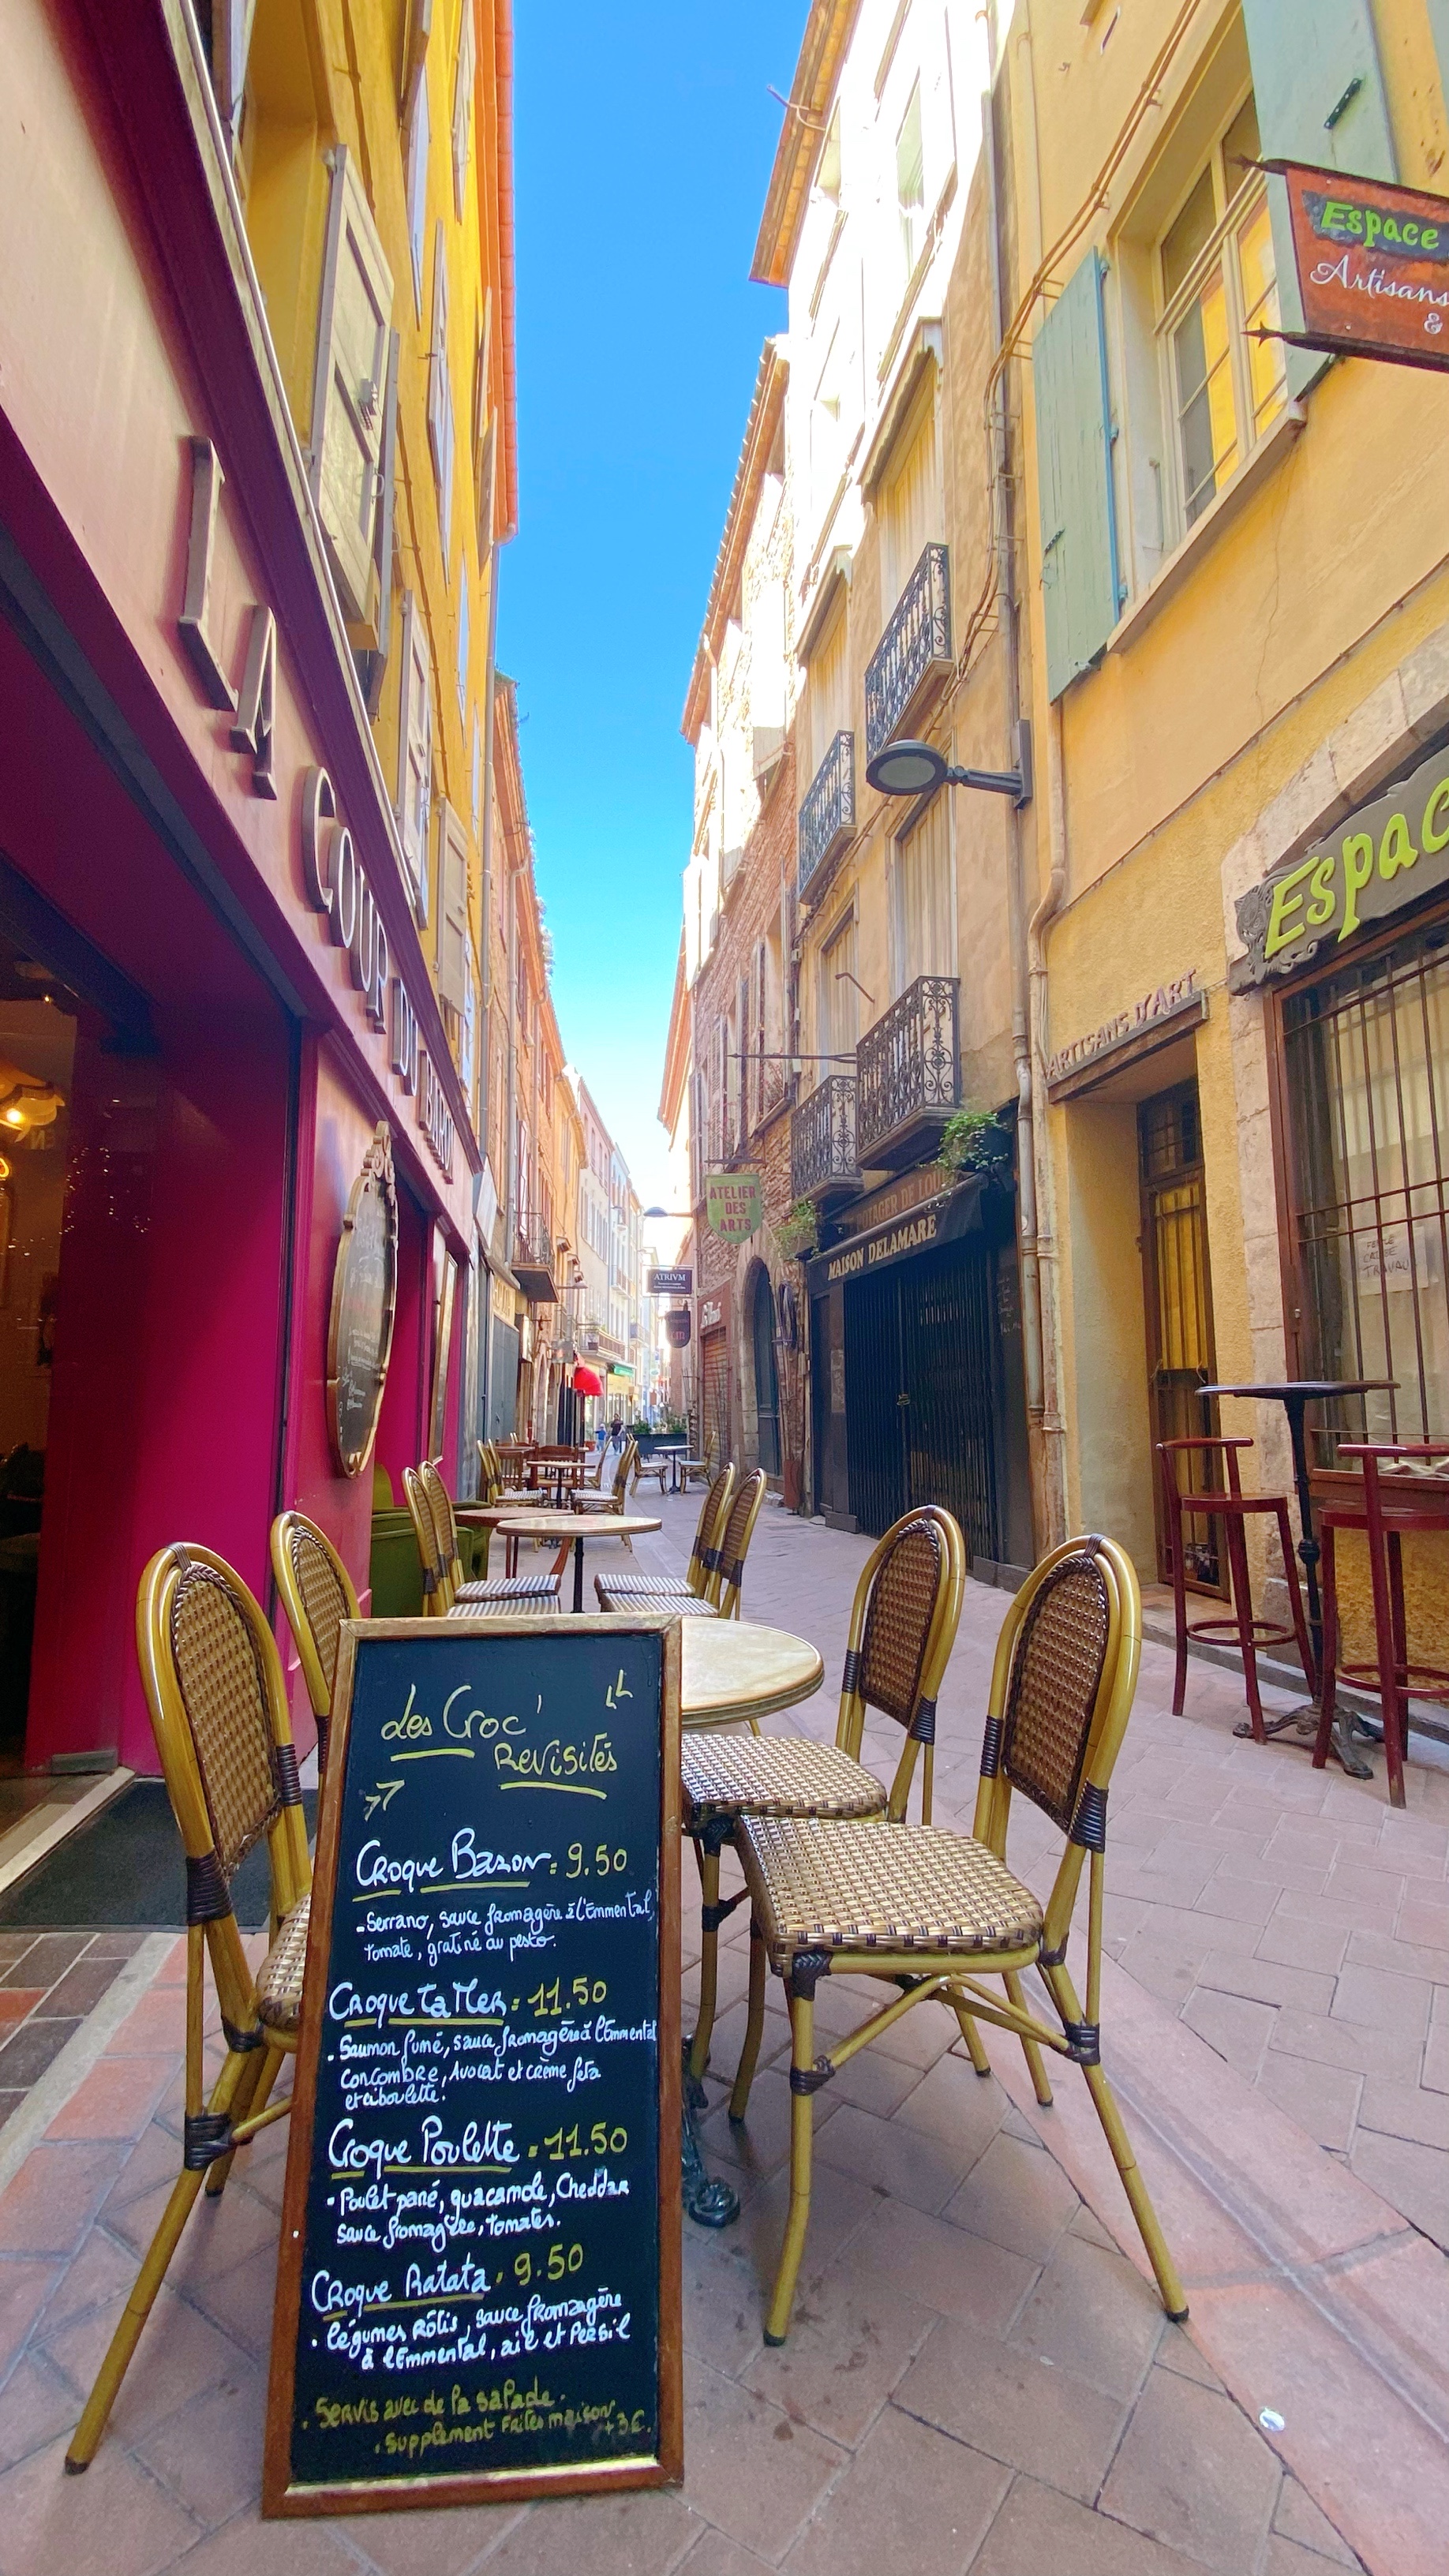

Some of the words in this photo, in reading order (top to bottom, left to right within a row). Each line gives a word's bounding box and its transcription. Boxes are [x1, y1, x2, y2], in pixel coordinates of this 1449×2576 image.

[1320, 200, 1440, 249] Espace
[1309, 253, 1449, 307] Artisans
[1423, 312, 1443, 335] &
[178, 435, 278, 801] LA
[301, 765, 388, 1035] COUR
[391, 977, 418, 1097] DU
[1046, 1012, 1129, 1080] ARTISANS
[709, 1185, 756, 1200] ATELIER
[724, 1201, 747, 1215] DES
[720, 1218, 751, 1232] ARTS
[827, 1247, 865, 1281] MAISON
[868, 1213, 938, 1264] DELAMARE
[565, 1842, 627, 1879] 9.50
[485, 1937, 504, 1950] au
[527, 1976, 608, 2017] 11.50
[544, 2121, 628, 2160] 11.50
[514, 2242, 584, 2286] 9.50
[423, 2389, 445, 2416] de
[451, 2383, 472, 2416] la
